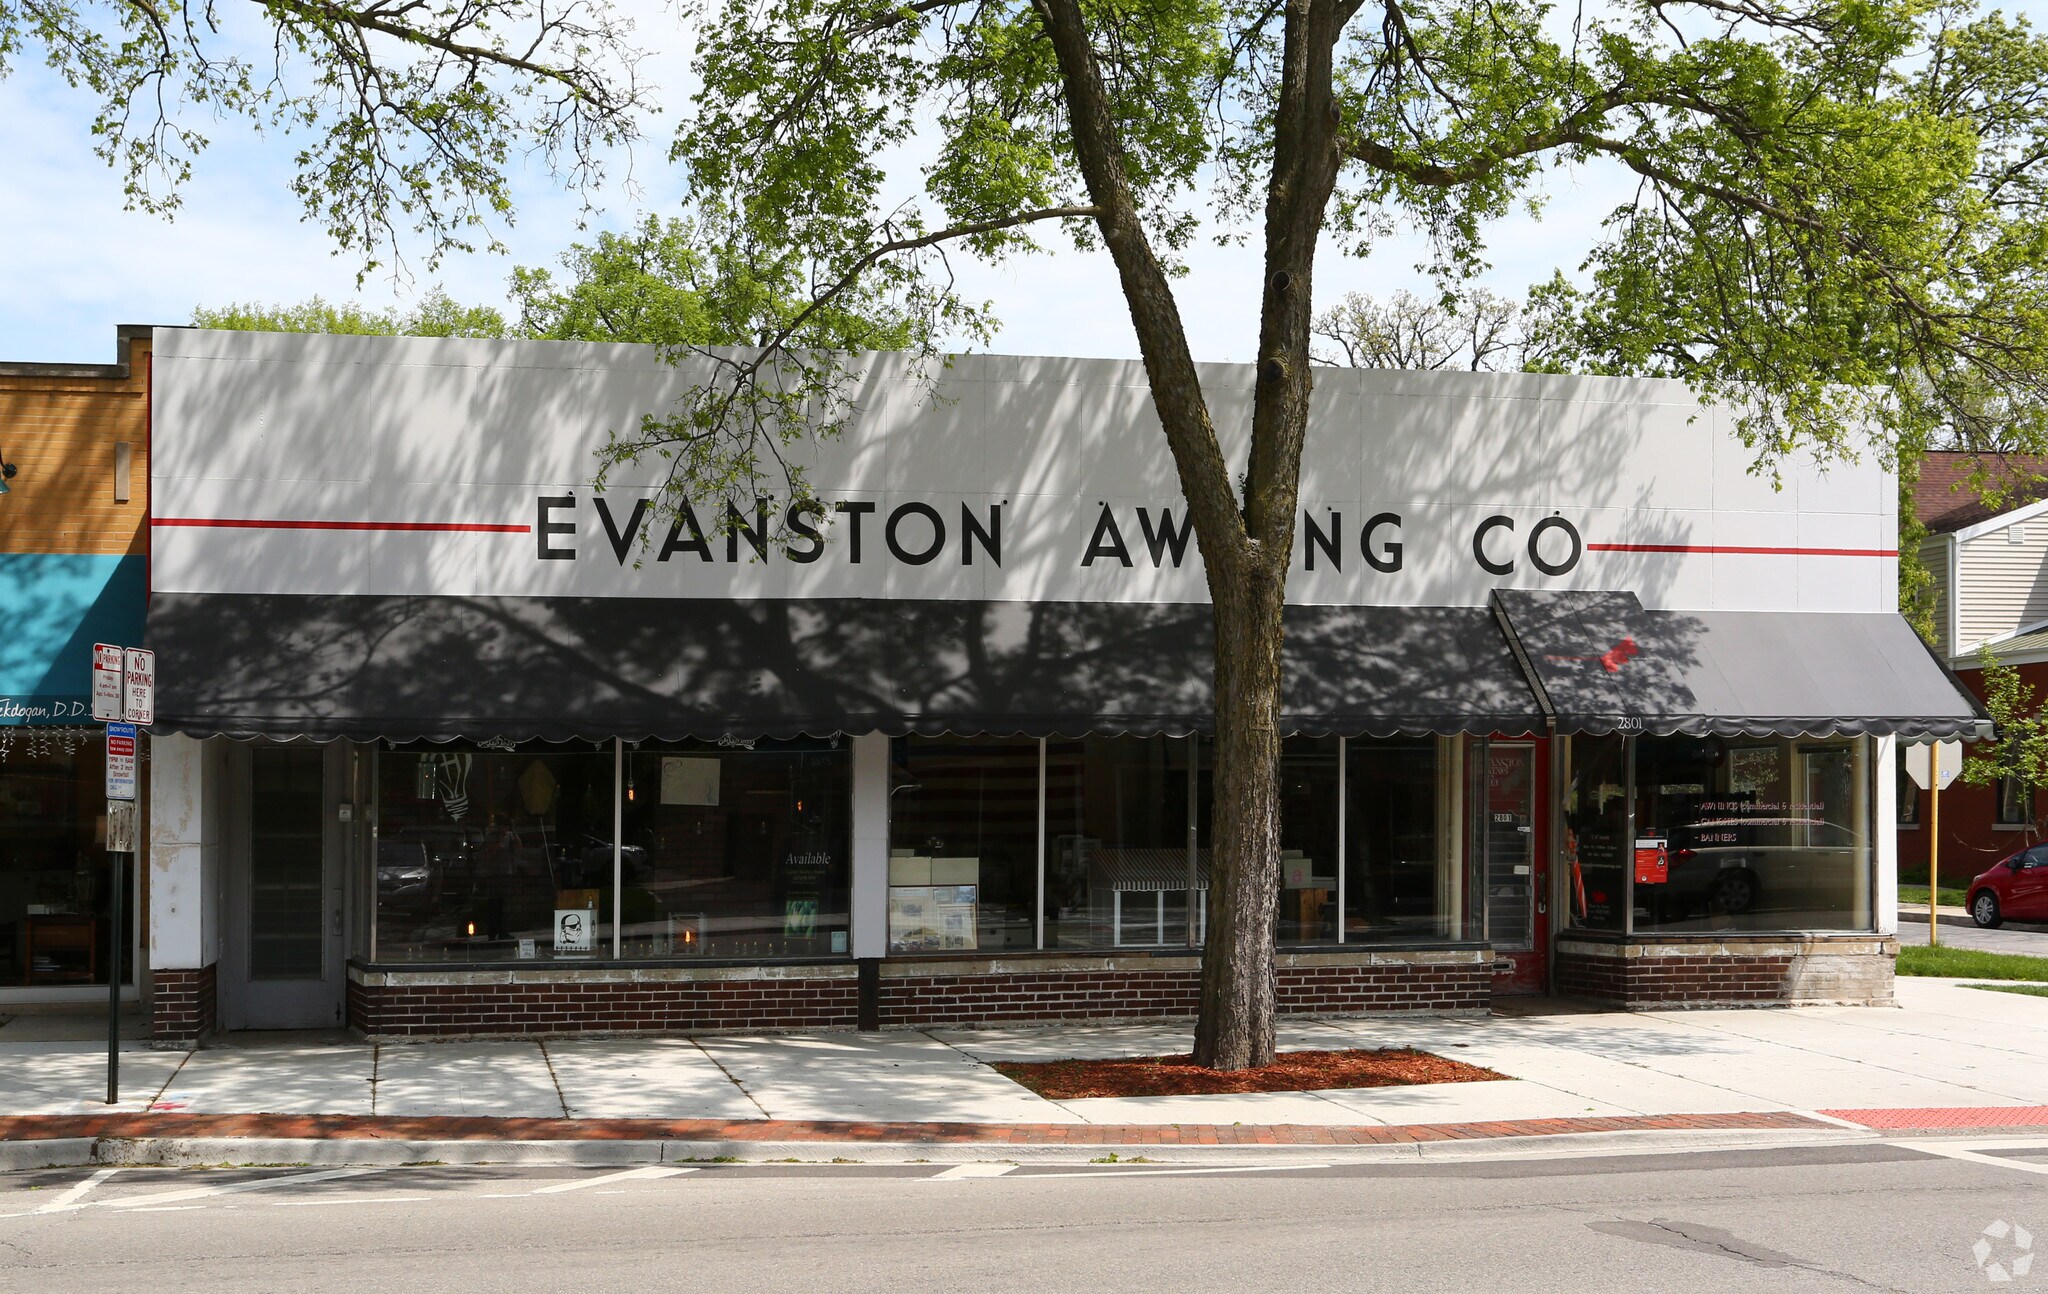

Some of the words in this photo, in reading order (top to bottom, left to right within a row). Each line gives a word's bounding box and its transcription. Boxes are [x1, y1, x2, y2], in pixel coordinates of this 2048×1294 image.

[537, 496, 1001, 569] EVANSTON
[1081, 501, 1402, 574] AWNG
[1472, 514, 1582, 576] CO
[103, 654, 121, 666] PARKING
[134, 656, 146, 671] NO
[127, 671, 152, 688] PARKING
[132, 687, 146, 698] HERE
[135, 698, 143, 709] TO
[128, 708, 150, 720] CORNER
[1617, 716, 1643, 730] 2801
[1495, 814, 1511, 822] 2801
[1701, 833, 1737, 842] BANNERS
[785, 852, 831, 865] Available
